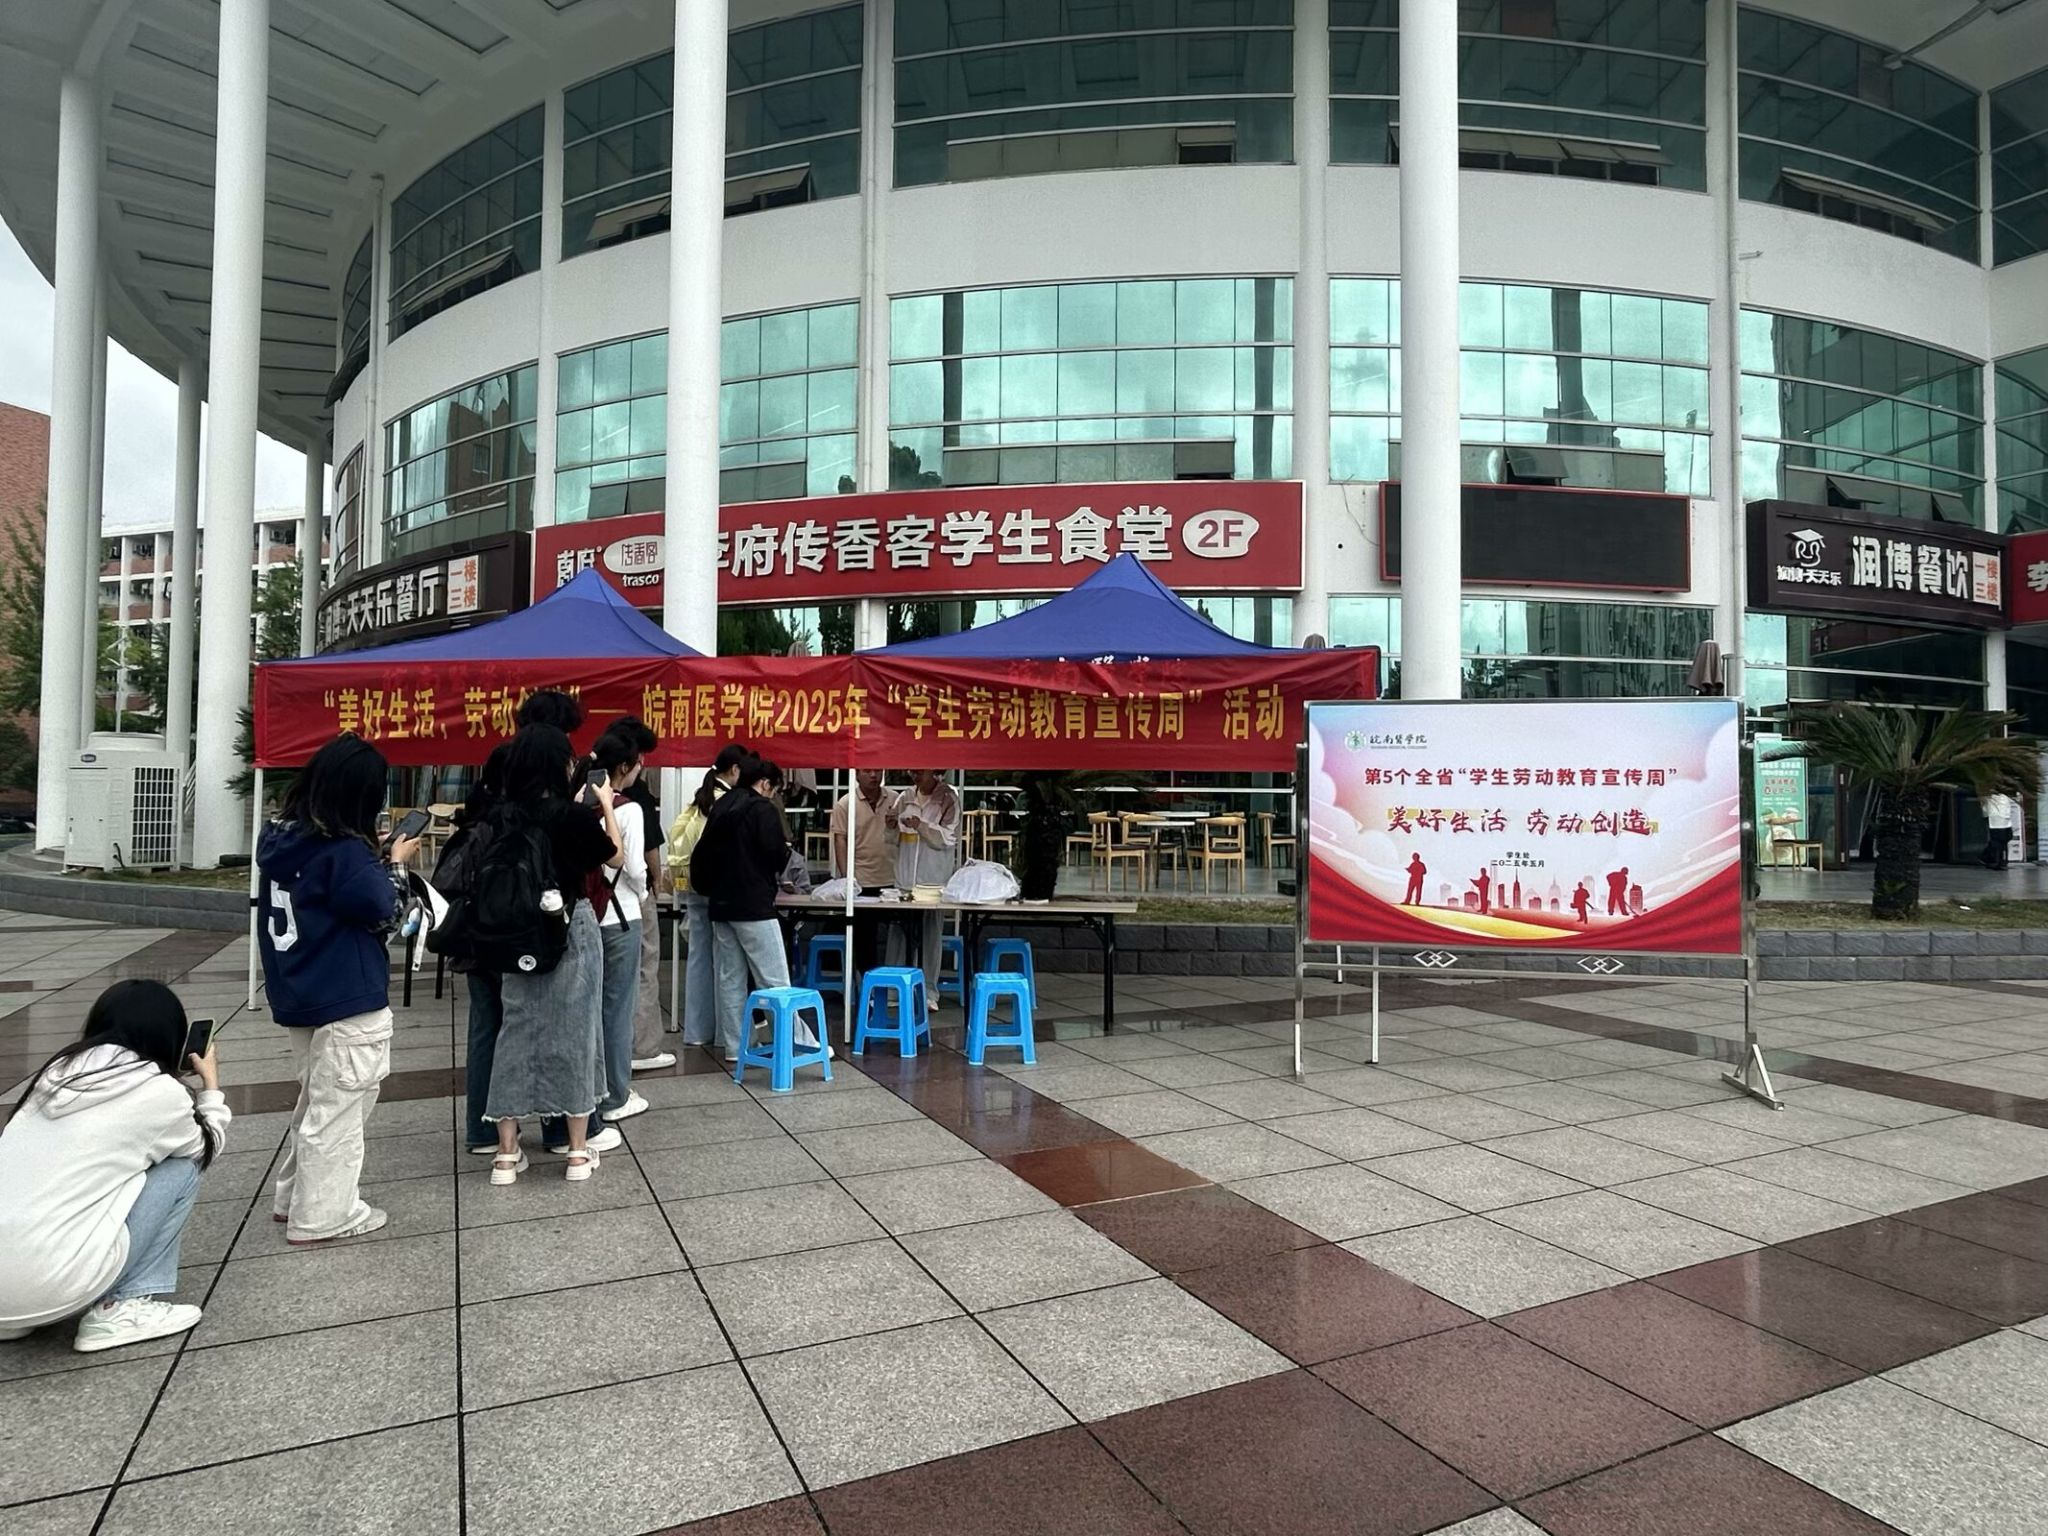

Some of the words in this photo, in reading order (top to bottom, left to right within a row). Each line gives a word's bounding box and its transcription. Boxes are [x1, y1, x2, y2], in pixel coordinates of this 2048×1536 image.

[1196, 520, 1245, 549] 2F
[622, 573, 660, 588] trasco
[1852, 535, 1968, 600] 润博餐饮
[1388, 806, 1508, 835] 美好生活
[1527, 807, 1653, 836] 劳动创造
